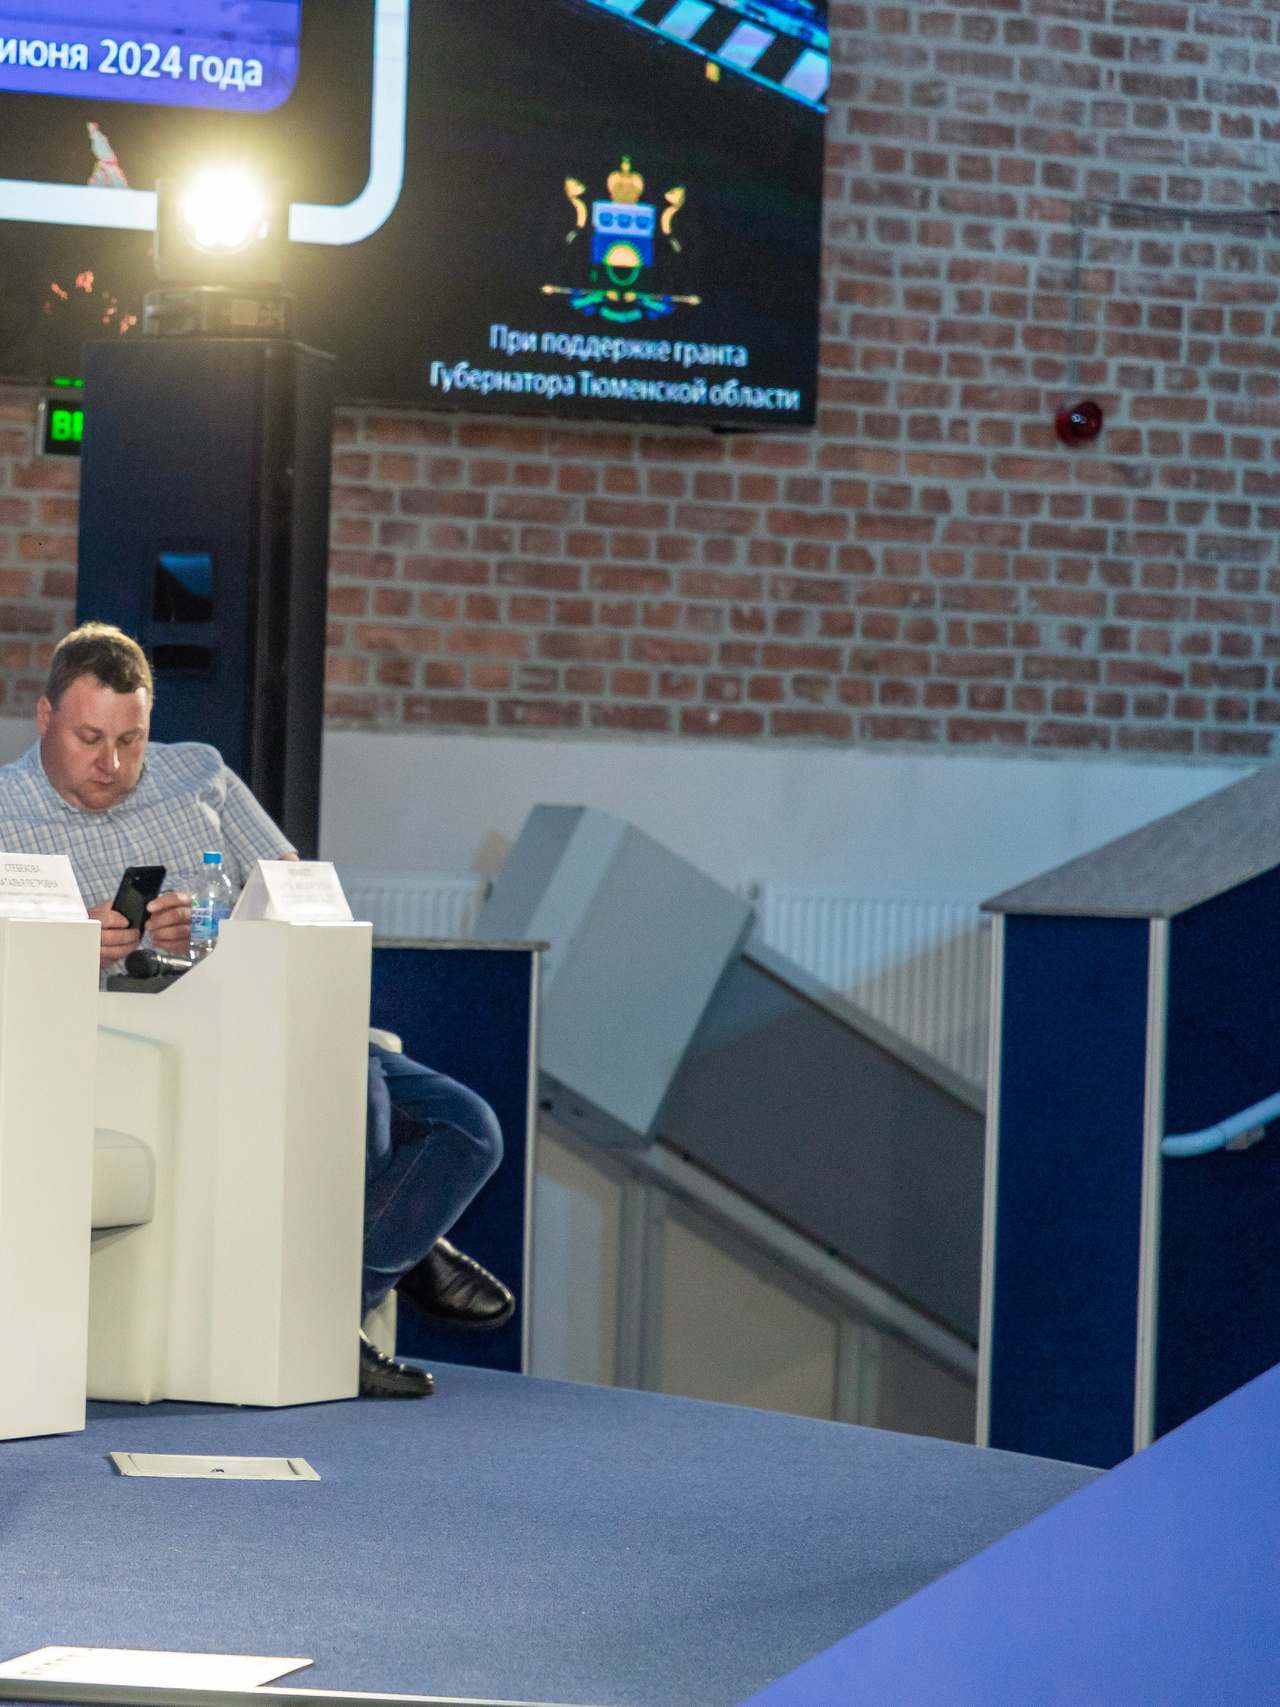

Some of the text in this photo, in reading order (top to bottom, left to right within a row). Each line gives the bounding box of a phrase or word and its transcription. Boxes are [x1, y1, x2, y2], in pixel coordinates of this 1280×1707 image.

[99, 39, 183, 80] 2024
[189, 56, 263, 91] года
[489, 323, 748, 368] При поддержке гранта
[429, 360, 800, 411] Губернатора Тюменской области
